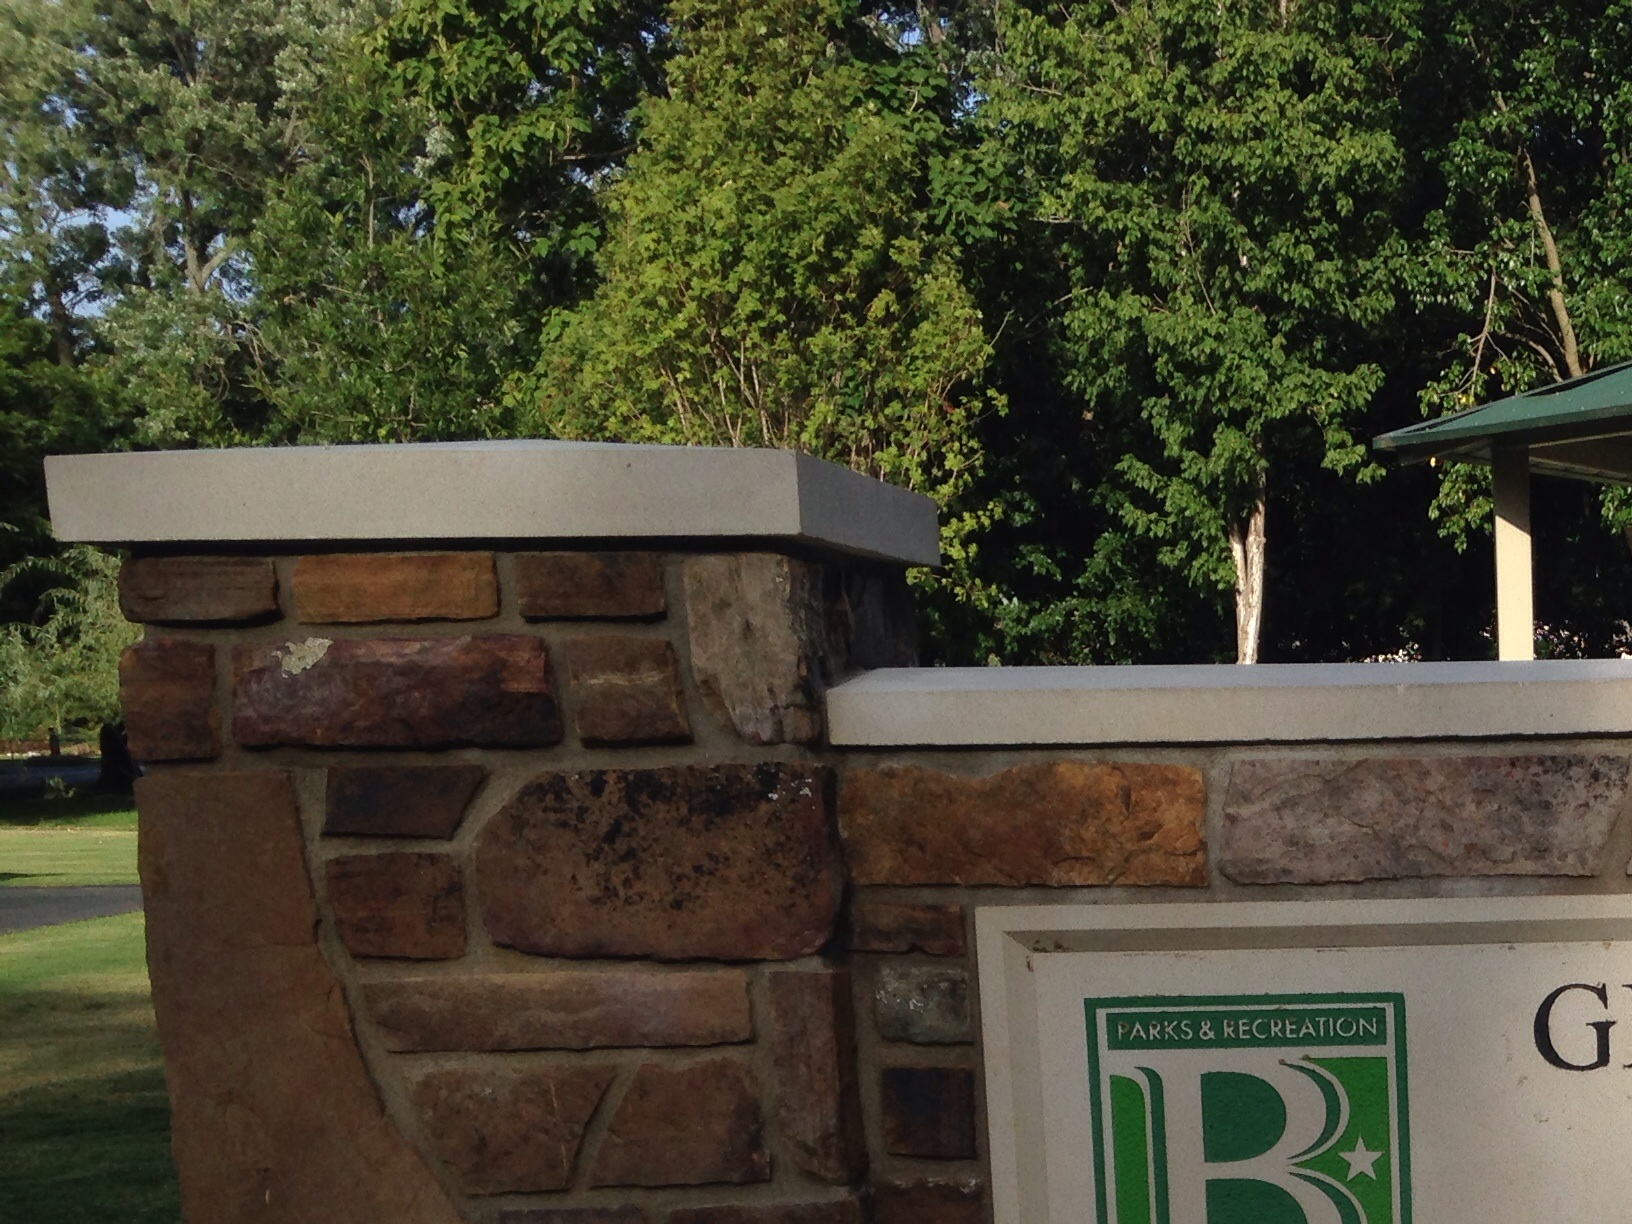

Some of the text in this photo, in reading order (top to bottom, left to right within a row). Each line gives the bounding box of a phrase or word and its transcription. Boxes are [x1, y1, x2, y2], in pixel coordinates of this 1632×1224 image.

[1117, 1016, 1379, 1042] PARKS & RECREATION
